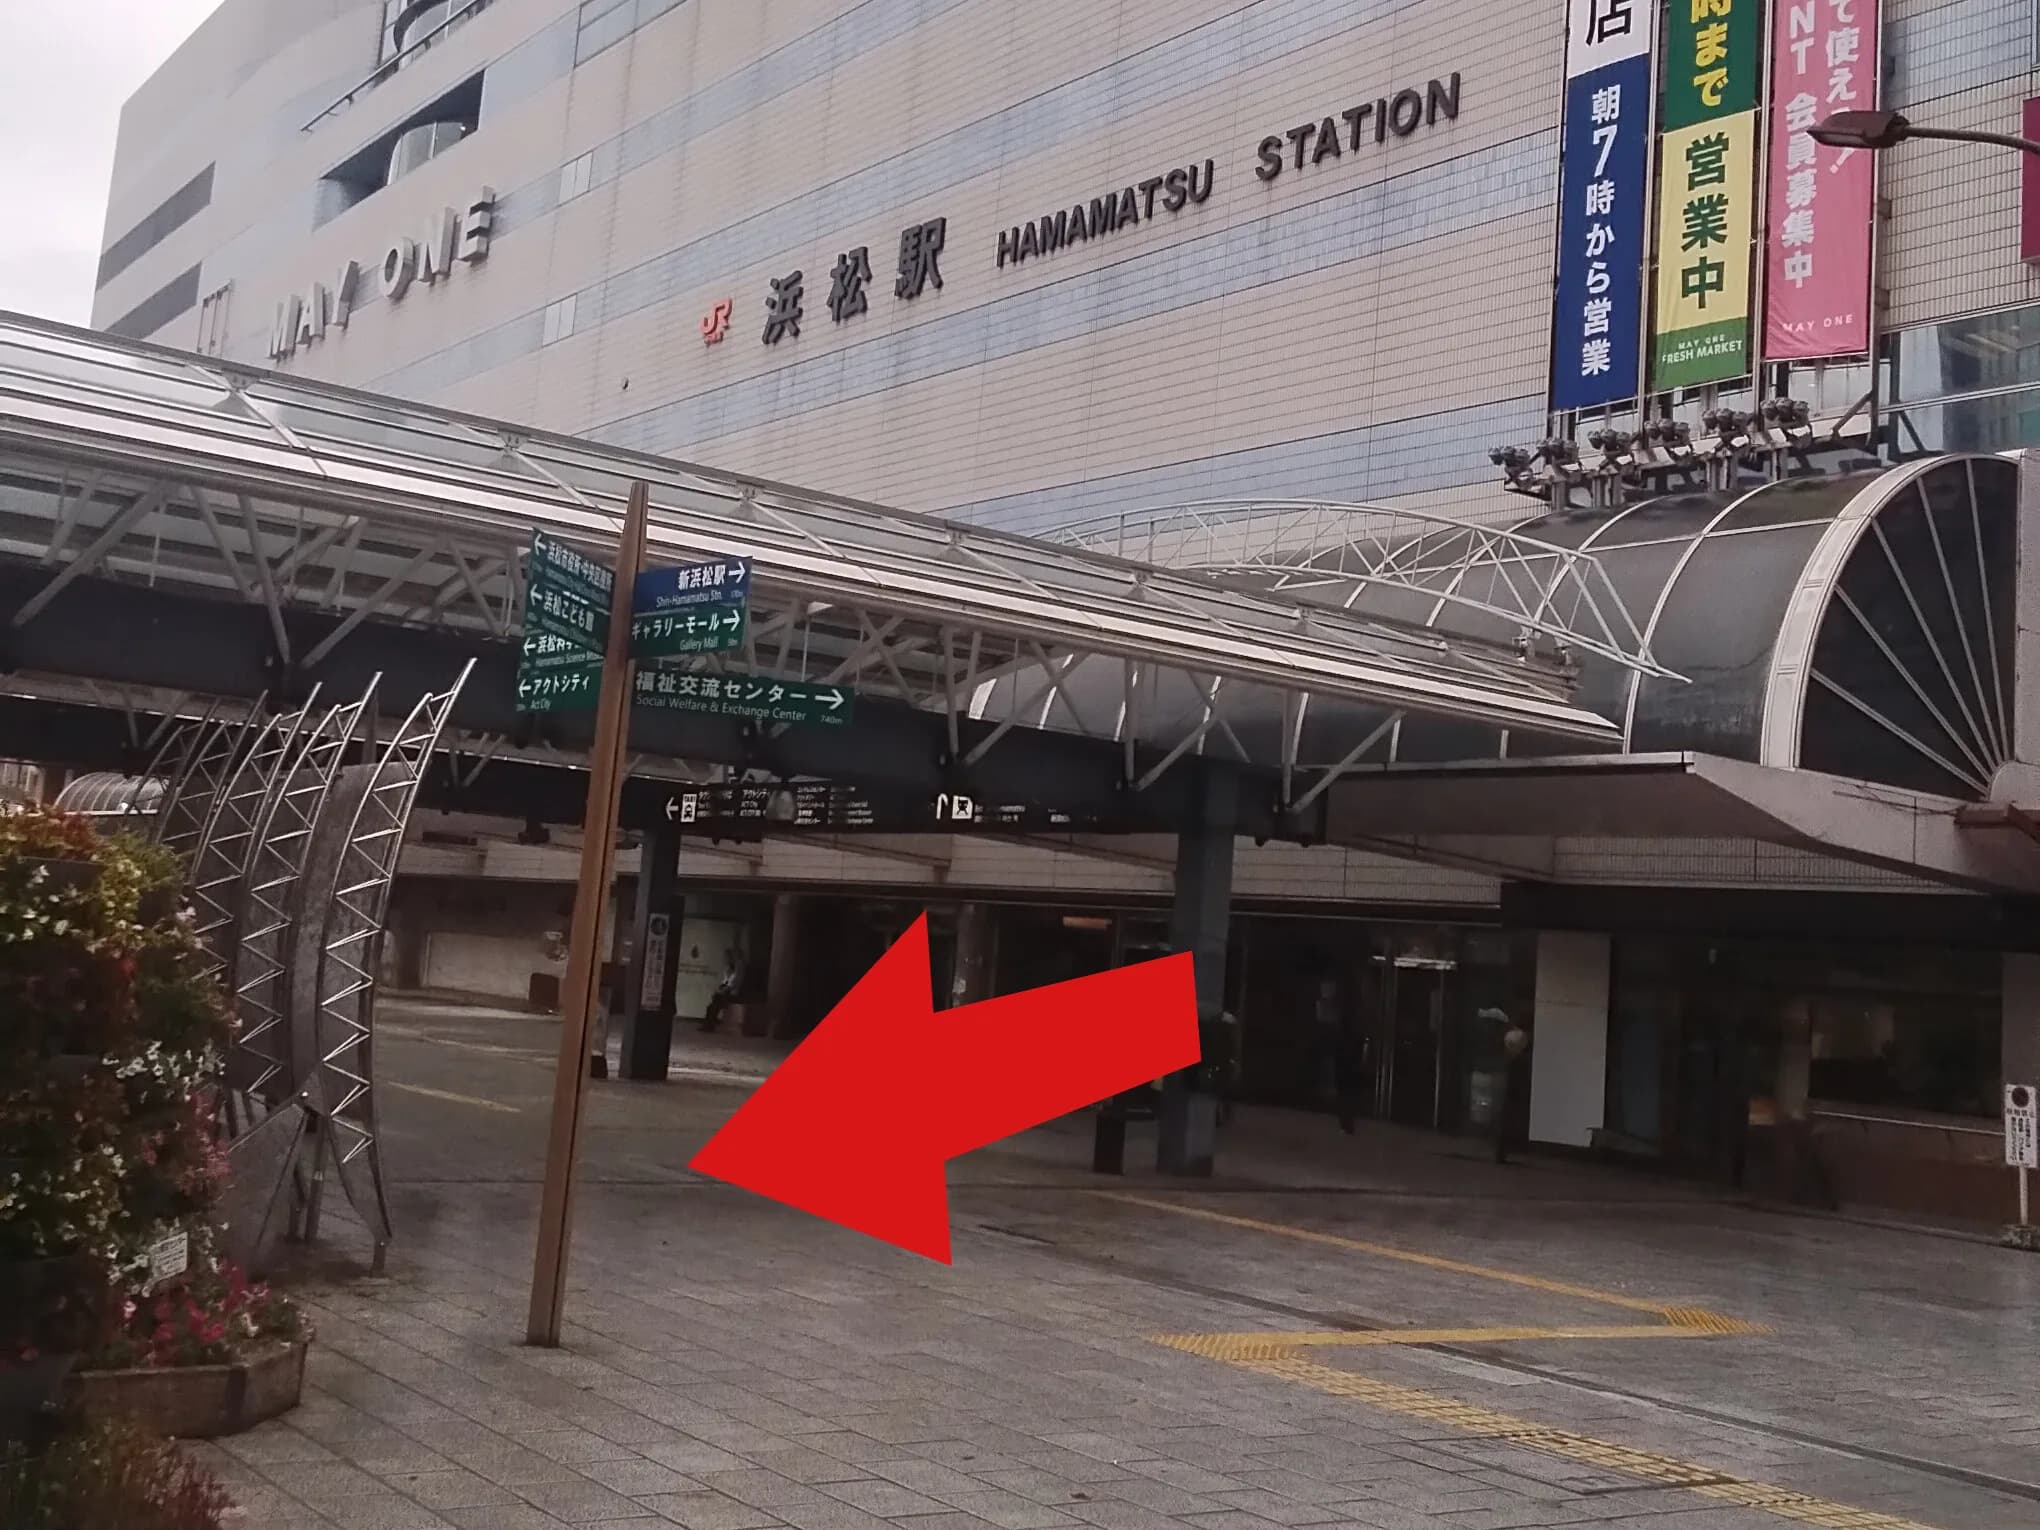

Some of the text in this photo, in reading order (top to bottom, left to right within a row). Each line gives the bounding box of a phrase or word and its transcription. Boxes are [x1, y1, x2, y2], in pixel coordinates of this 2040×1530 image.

[1825, 0, 1861, 174] て使え!
[996, 71, 1461, 268] HAMAMATSU STATION
[1781, 92, 1817, 289] 会員募集中
[1581, 84, 1622, 377] 朝7時から営業
[1680, 131, 1730, 310] 営業中
[268, 185, 496, 360] MAY ONE
[698, 216, 947, 346] JR 浜松駅
[1782, 314, 1854, 333] MAY ONE
[1661, 340, 1743, 365] FRESH MARKET
[1677, 333, 1726, 351] MAY ONE
[678, 564, 727, 591] 新浜松駅
[631, 612, 720, 641] ギャラリーモール
[533, 673, 590, 696] アクトシティ
[635, 671, 808, 703] 福祉交流センター
[636, 695, 807, 721] Social Welfare & Exchange Center
